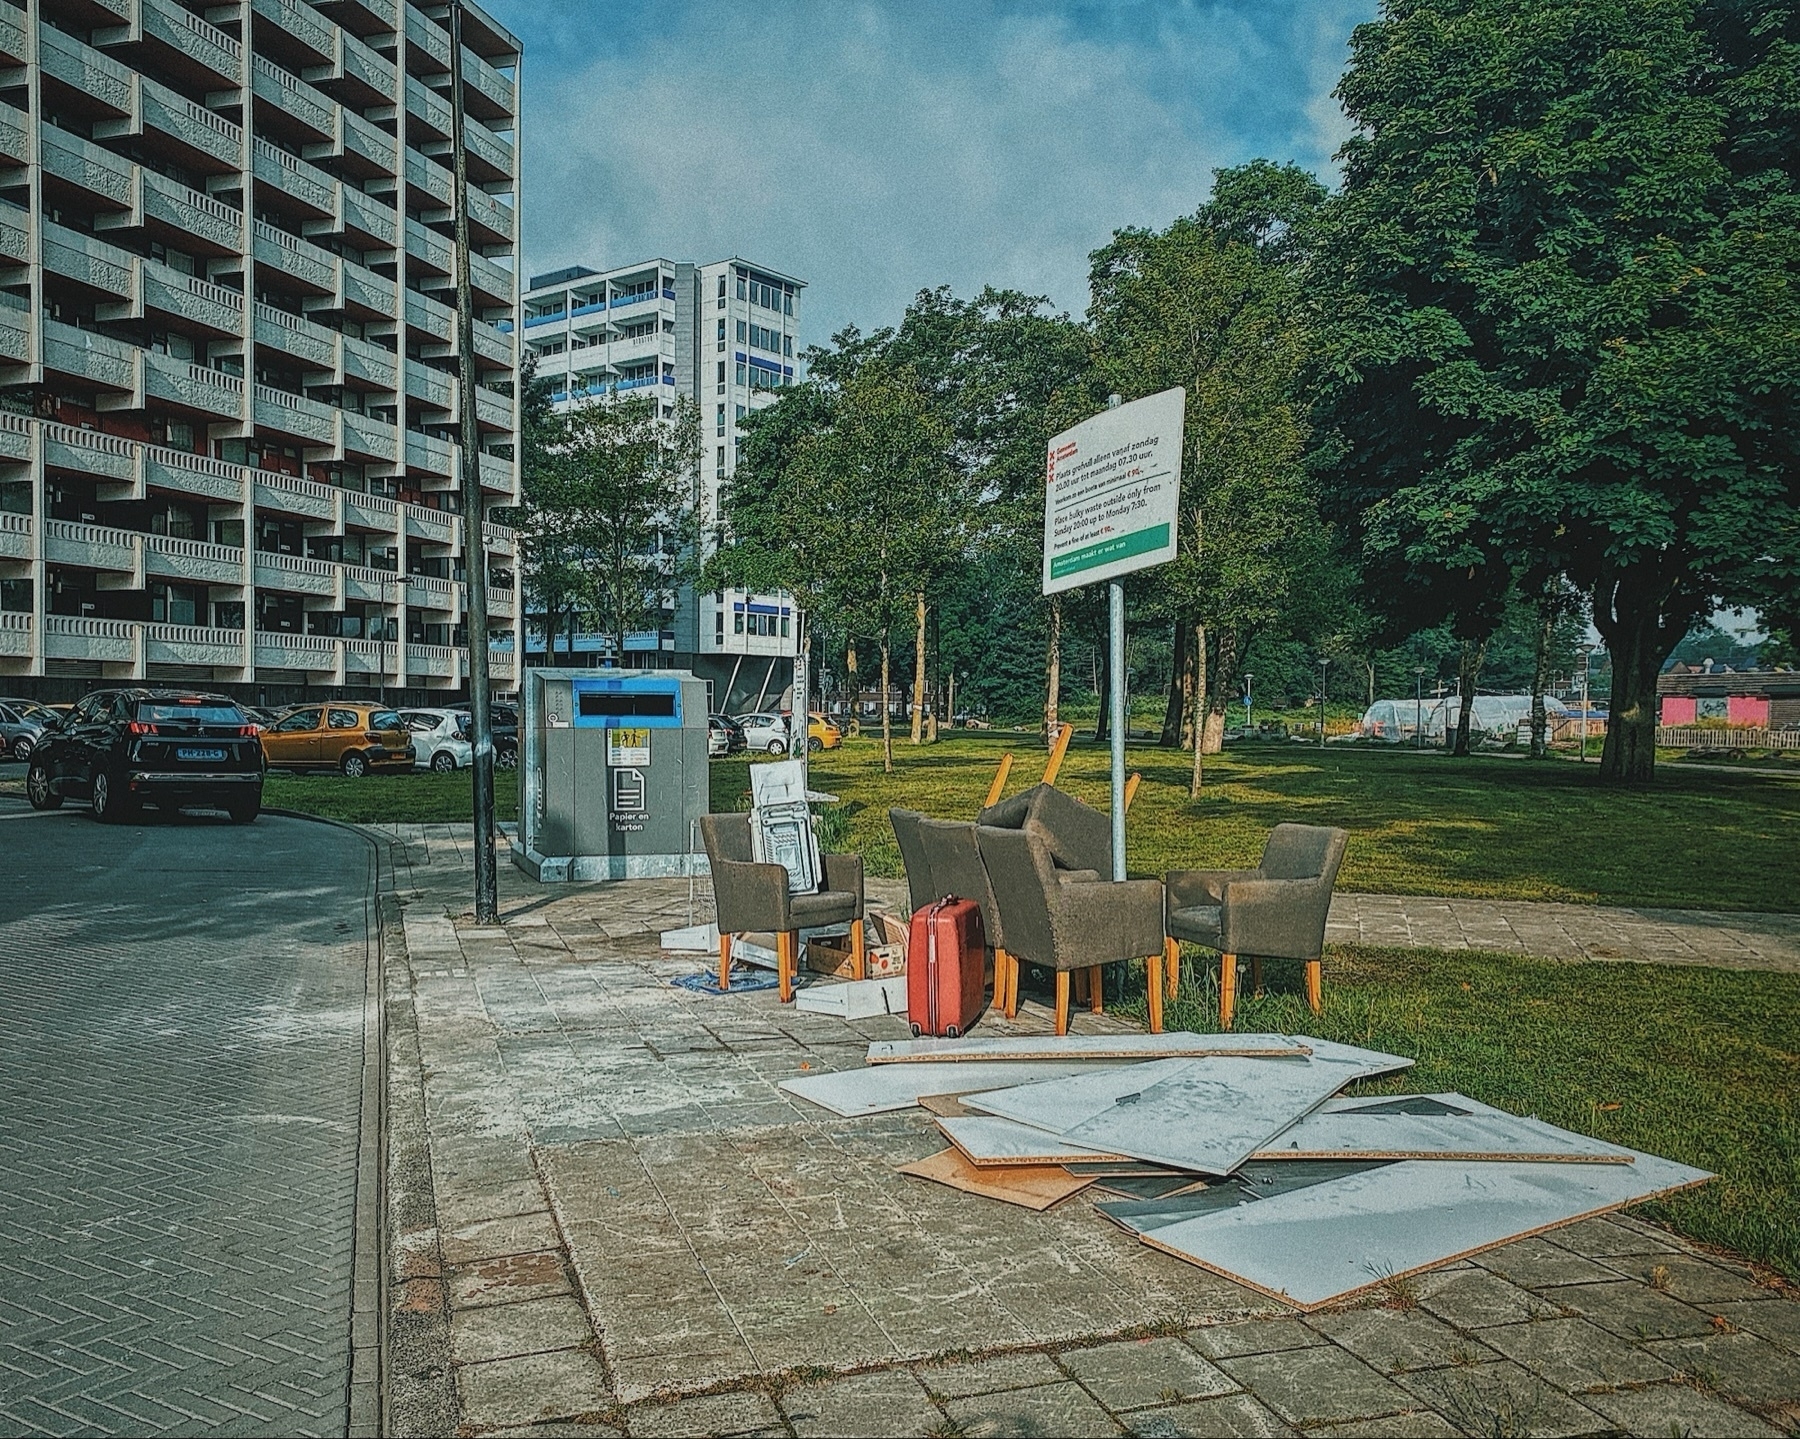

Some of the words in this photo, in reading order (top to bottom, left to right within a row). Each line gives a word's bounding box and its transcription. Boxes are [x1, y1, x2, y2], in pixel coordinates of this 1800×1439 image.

[1055, 479, 1070, 492] 20.00
[1070, 477, 1080, 486] uur
[1080, 472, 1089, 481] tot
[1090, 462, 1117, 478] maandag
[1118, 453, 1138, 466] 07.30
[1139, 450, 1153, 460] uur.
[1056, 469, 1071, 481] Plaats
[1072, 457, 1093, 476] grofvuil
[1093, 453, 1111, 465] alleen
[1112, 442, 1130, 457] vanaf
[1131, 436, 1159, 450] zondag
[1054, 515, 1068, 526] Place
[1069, 509, 1084, 519] bulky
[1084, 502, 1102, 515] waste
[1103, 492, 1126, 508] outside
[1127, 488, 1142, 499] only
[1143, 484, 1161, 495] from
[1054, 524, 1073, 537] Sunday
[1073, 518, 1089, 531] 20:00
[1089, 517, 1097, 526] up
[1098, 513, 1105, 521] to
[1105, 503, 1131, 519] Monday
[1130, 498, 1148, 511] 7:30.
[1053, 555, 1081, 569] Amsterdam
[1081, 549, 1097, 560] maakt
[1104, 544, 1115, 552] wat
[1115, 541, 1126, 549] van
[609, 812, 637, 822] Papier
[638, 813, 649, 821] en
[615, 823, 643, 831] karton
